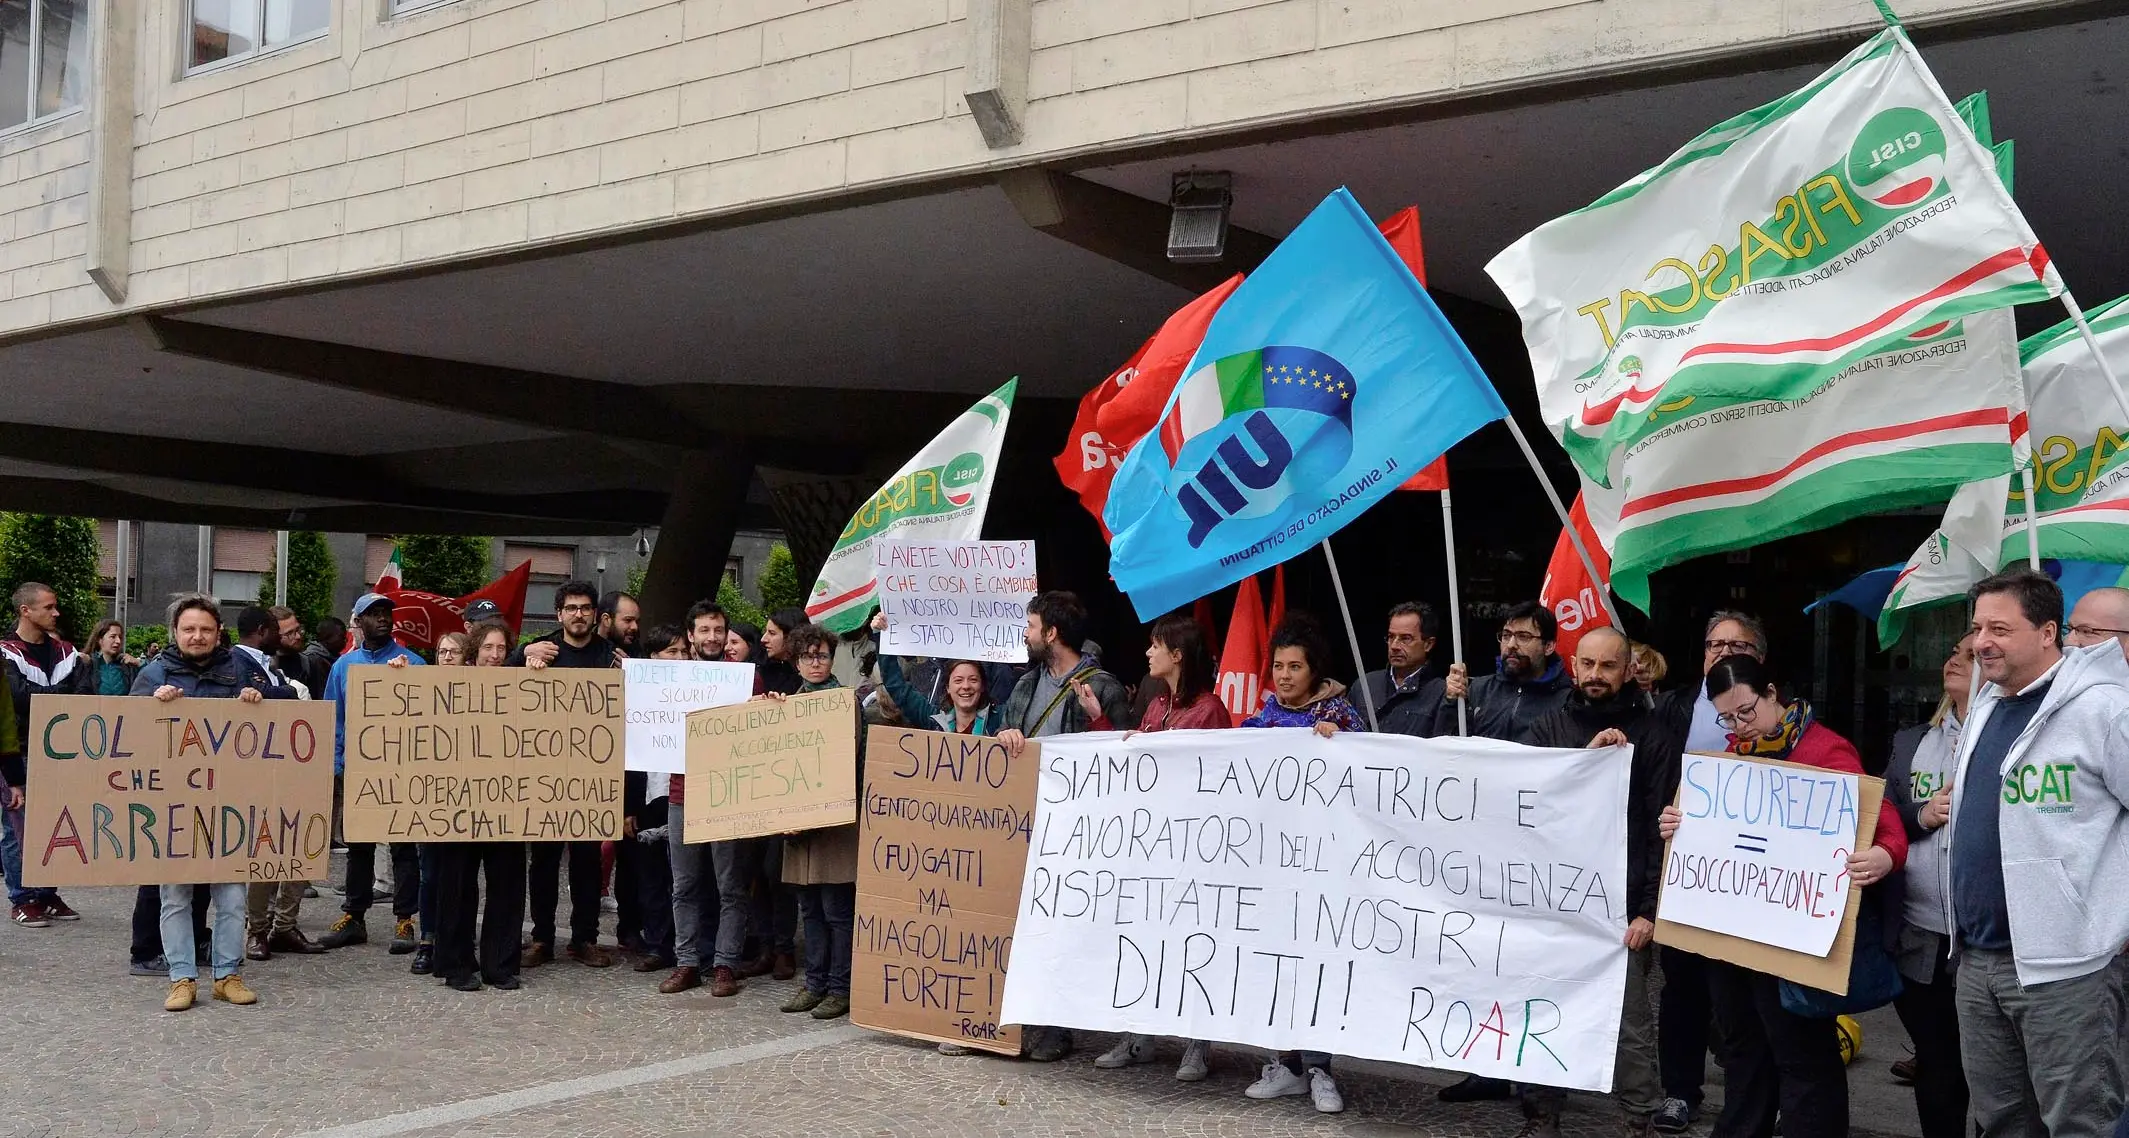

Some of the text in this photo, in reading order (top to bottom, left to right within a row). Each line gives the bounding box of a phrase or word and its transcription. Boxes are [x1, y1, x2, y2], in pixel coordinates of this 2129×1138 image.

[886, 575, 920, 592] CHE
[928, 575, 969, 593] COSA
[975, 573, 986, 593] È
[882, 598, 1024, 619] IL NOSTRO LAVORO
[889, 619, 900, 645] È
[910, 624, 954, 646] STATO
[363, 679, 620, 718] E SE NELLE STRADE
[43, 713, 316, 763] COL TAVOLO
[688, 706, 786, 738] ACCOGLIENZA
[359, 724, 614, 765] CHIEDI IL DECORO
[652, 735, 677, 749] NON
[730, 729, 825, 759] ACCOGLIENZA
[893, 733, 1009, 788] SIAMO
[107, 768, 214, 791] CHE CI
[538, 775, 619, 804] SOCIALE
[1044, 752, 1538, 828] SIAMO LAVORATRICI E
[1686, 761, 1856, 836] SICUREZZA
[2036, 806, 2074, 814] TRENTINO
[42, 803, 328, 866] ARRENDIAMO
[388, 807, 615, 839] LASCIA IL LAVORO
[1040, 808, 1264, 867] LAVORATORI
[1350, 839, 1611, 919] ACCOGLIENZA
[919, 888, 953, 918] MA
[1030, 867, 1263, 932] RISPETTATE
[1315, 893, 1505, 976] NOSTRI
[857, 914, 1013, 975] MIAGOLIAMO
[1403, 986, 1568, 1071] ROAR
